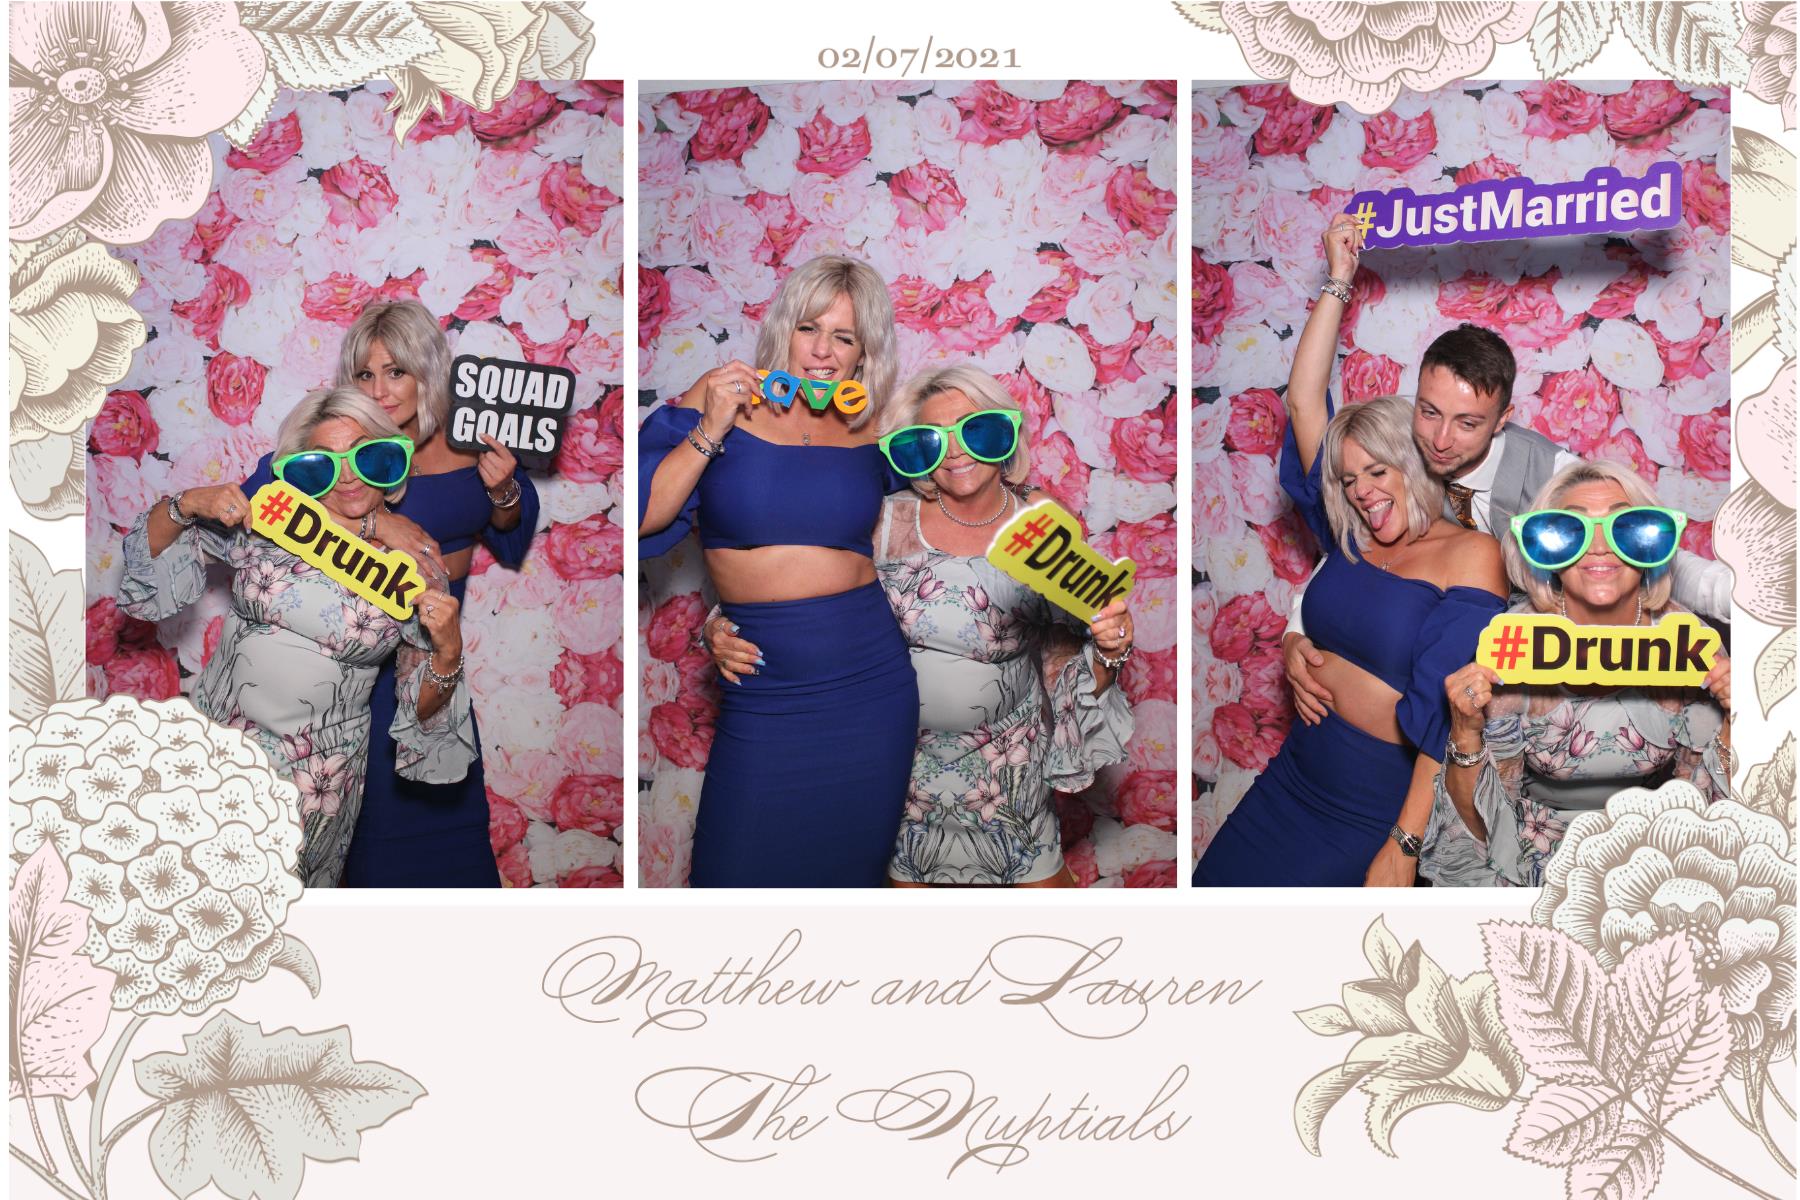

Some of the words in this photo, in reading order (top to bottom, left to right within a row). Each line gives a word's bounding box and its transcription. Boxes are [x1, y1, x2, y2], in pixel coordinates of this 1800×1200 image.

[1351, 172, 1672, 240] #JustMarried
[455, 361, 570, 410] SQUAD
[452, 406, 558, 453] GOALS
[259, 489, 419, 609] #Drunk
[1003, 513, 1130, 610] #Drunk
[1490, 624, 1712, 673] #Drunk
